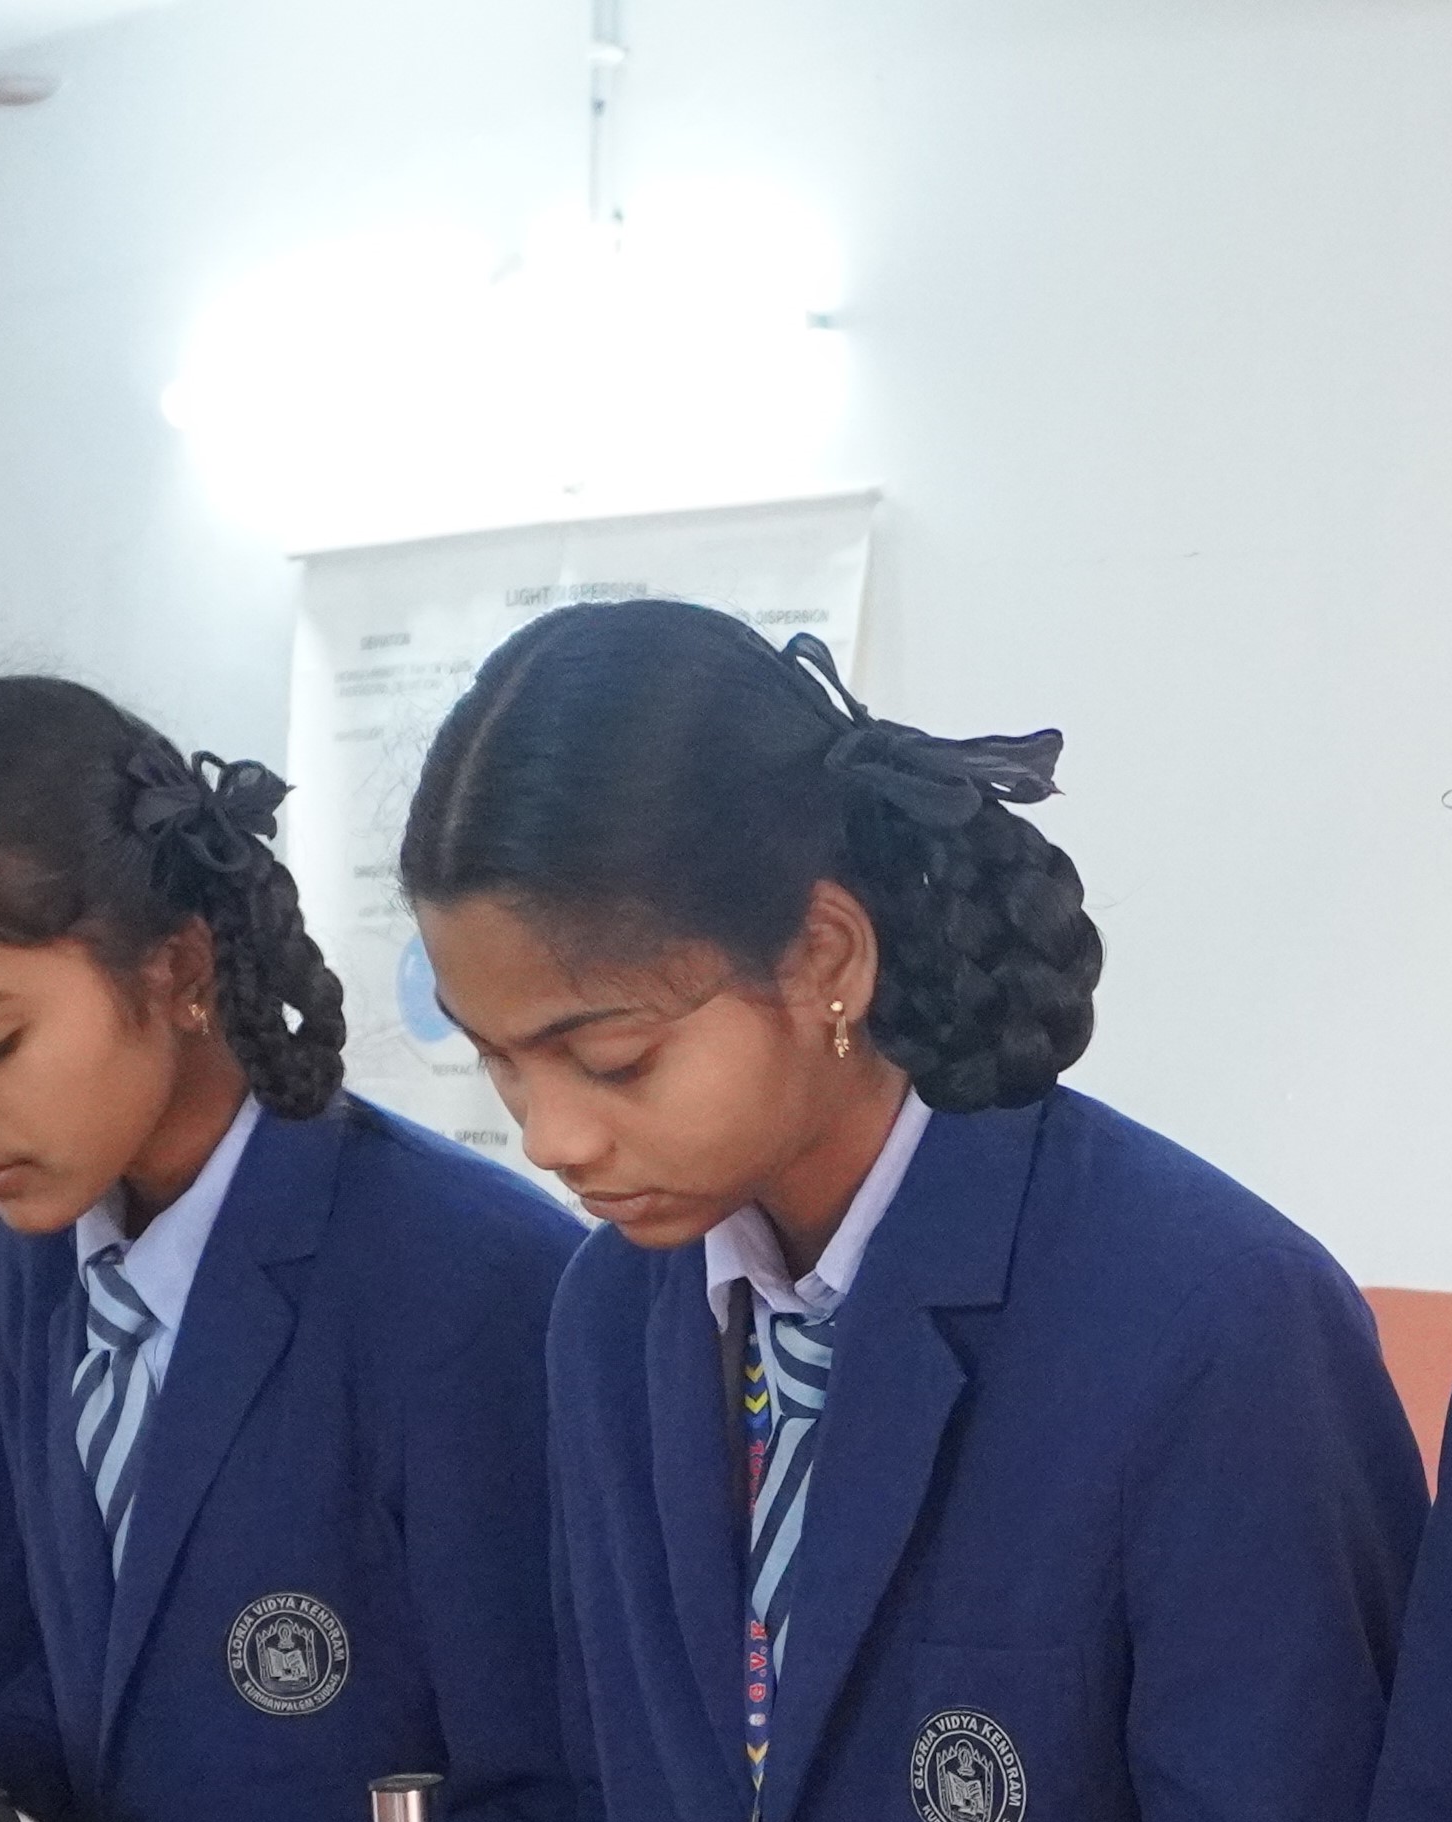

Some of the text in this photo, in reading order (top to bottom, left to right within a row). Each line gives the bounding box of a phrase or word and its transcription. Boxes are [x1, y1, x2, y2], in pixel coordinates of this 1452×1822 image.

[505, 586, 550, 607] LIGHT
[232, 1596, 345, 1670] GLORIA VIDYA KENDRAM
[914, 1715, 1022, 1807] GLORIA VIDYA KENDRAM
